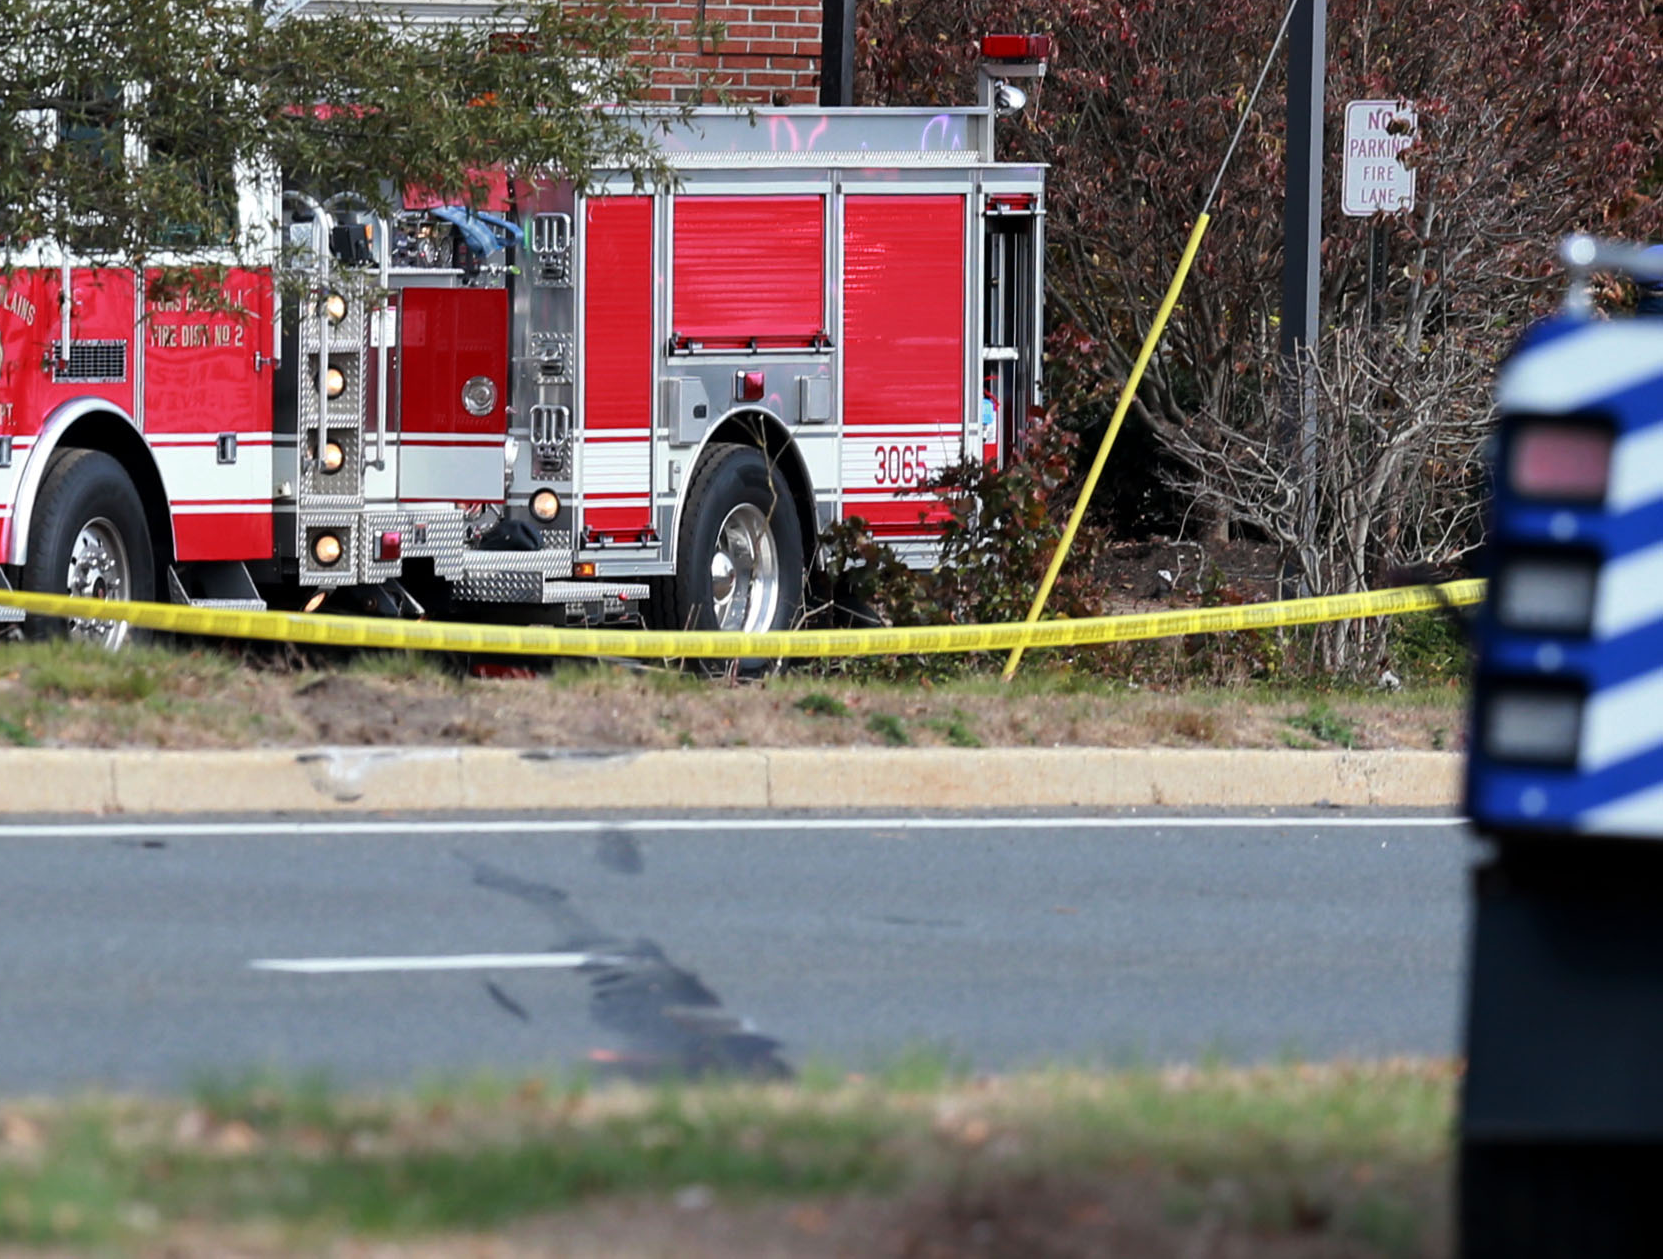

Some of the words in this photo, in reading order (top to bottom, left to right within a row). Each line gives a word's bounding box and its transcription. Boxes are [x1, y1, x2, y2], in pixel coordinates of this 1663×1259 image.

[1368, 110, 1394, 130] NO
[1363, 166, 1394, 181] FIRE
[1361, 189, 1396, 204] LANE
[151, 325, 177, 347] FIRE
[235, 325, 244, 347] 2
[874, 445, 927, 485] 3065
